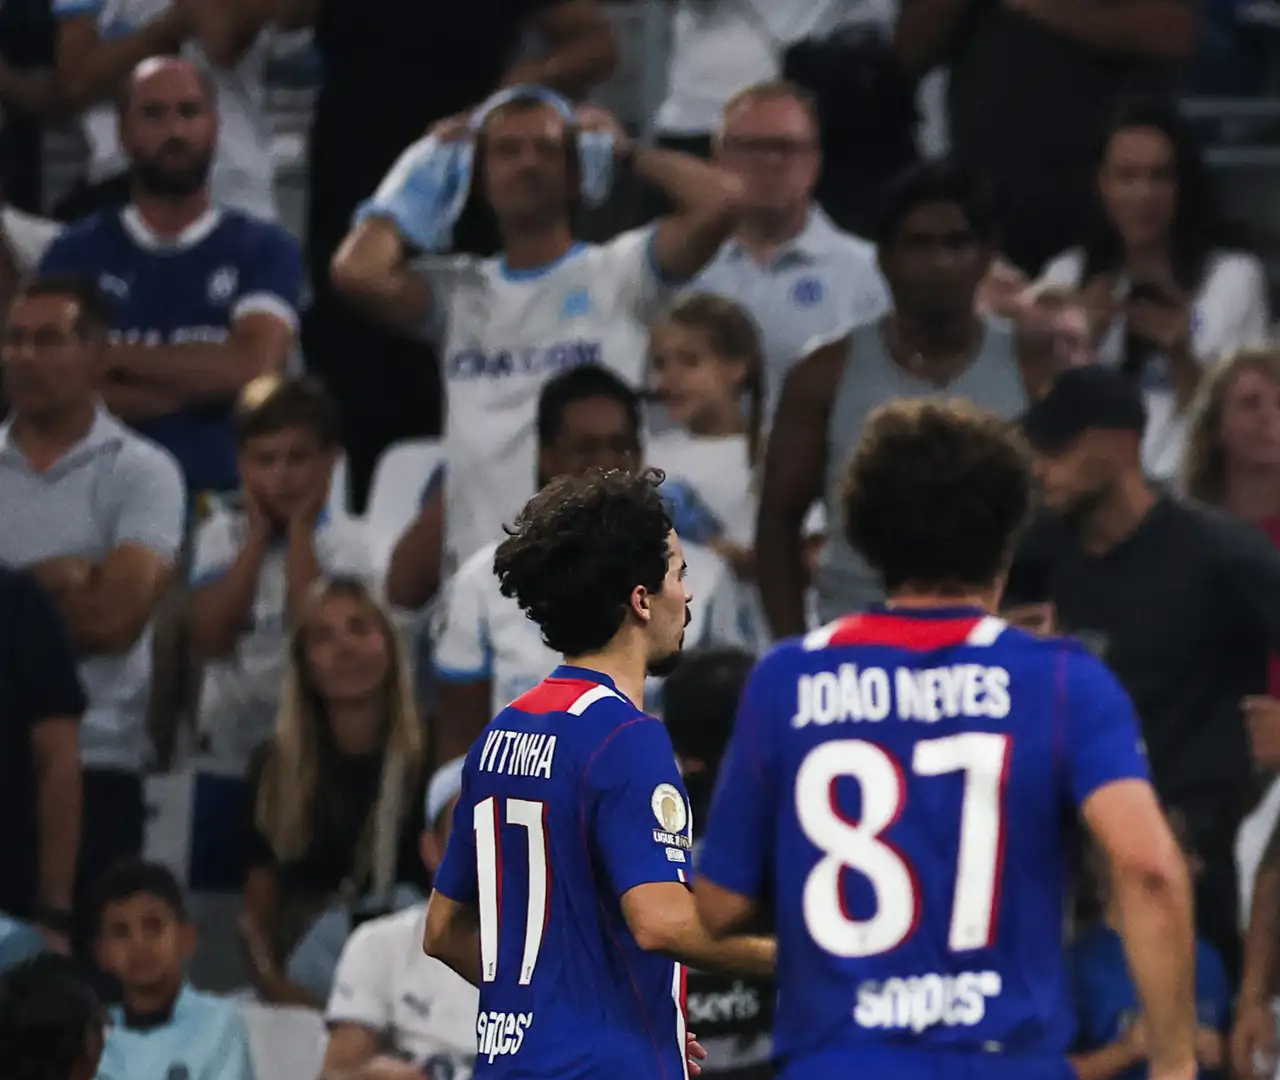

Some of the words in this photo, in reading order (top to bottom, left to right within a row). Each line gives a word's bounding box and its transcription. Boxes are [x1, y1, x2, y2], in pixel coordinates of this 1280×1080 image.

[478, 729, 557, 780] VITINHA
[790, 662, 891, 729] JOÃO
[474, 796, 551, 986] 17
[794, 731, 1014, 958] 87
